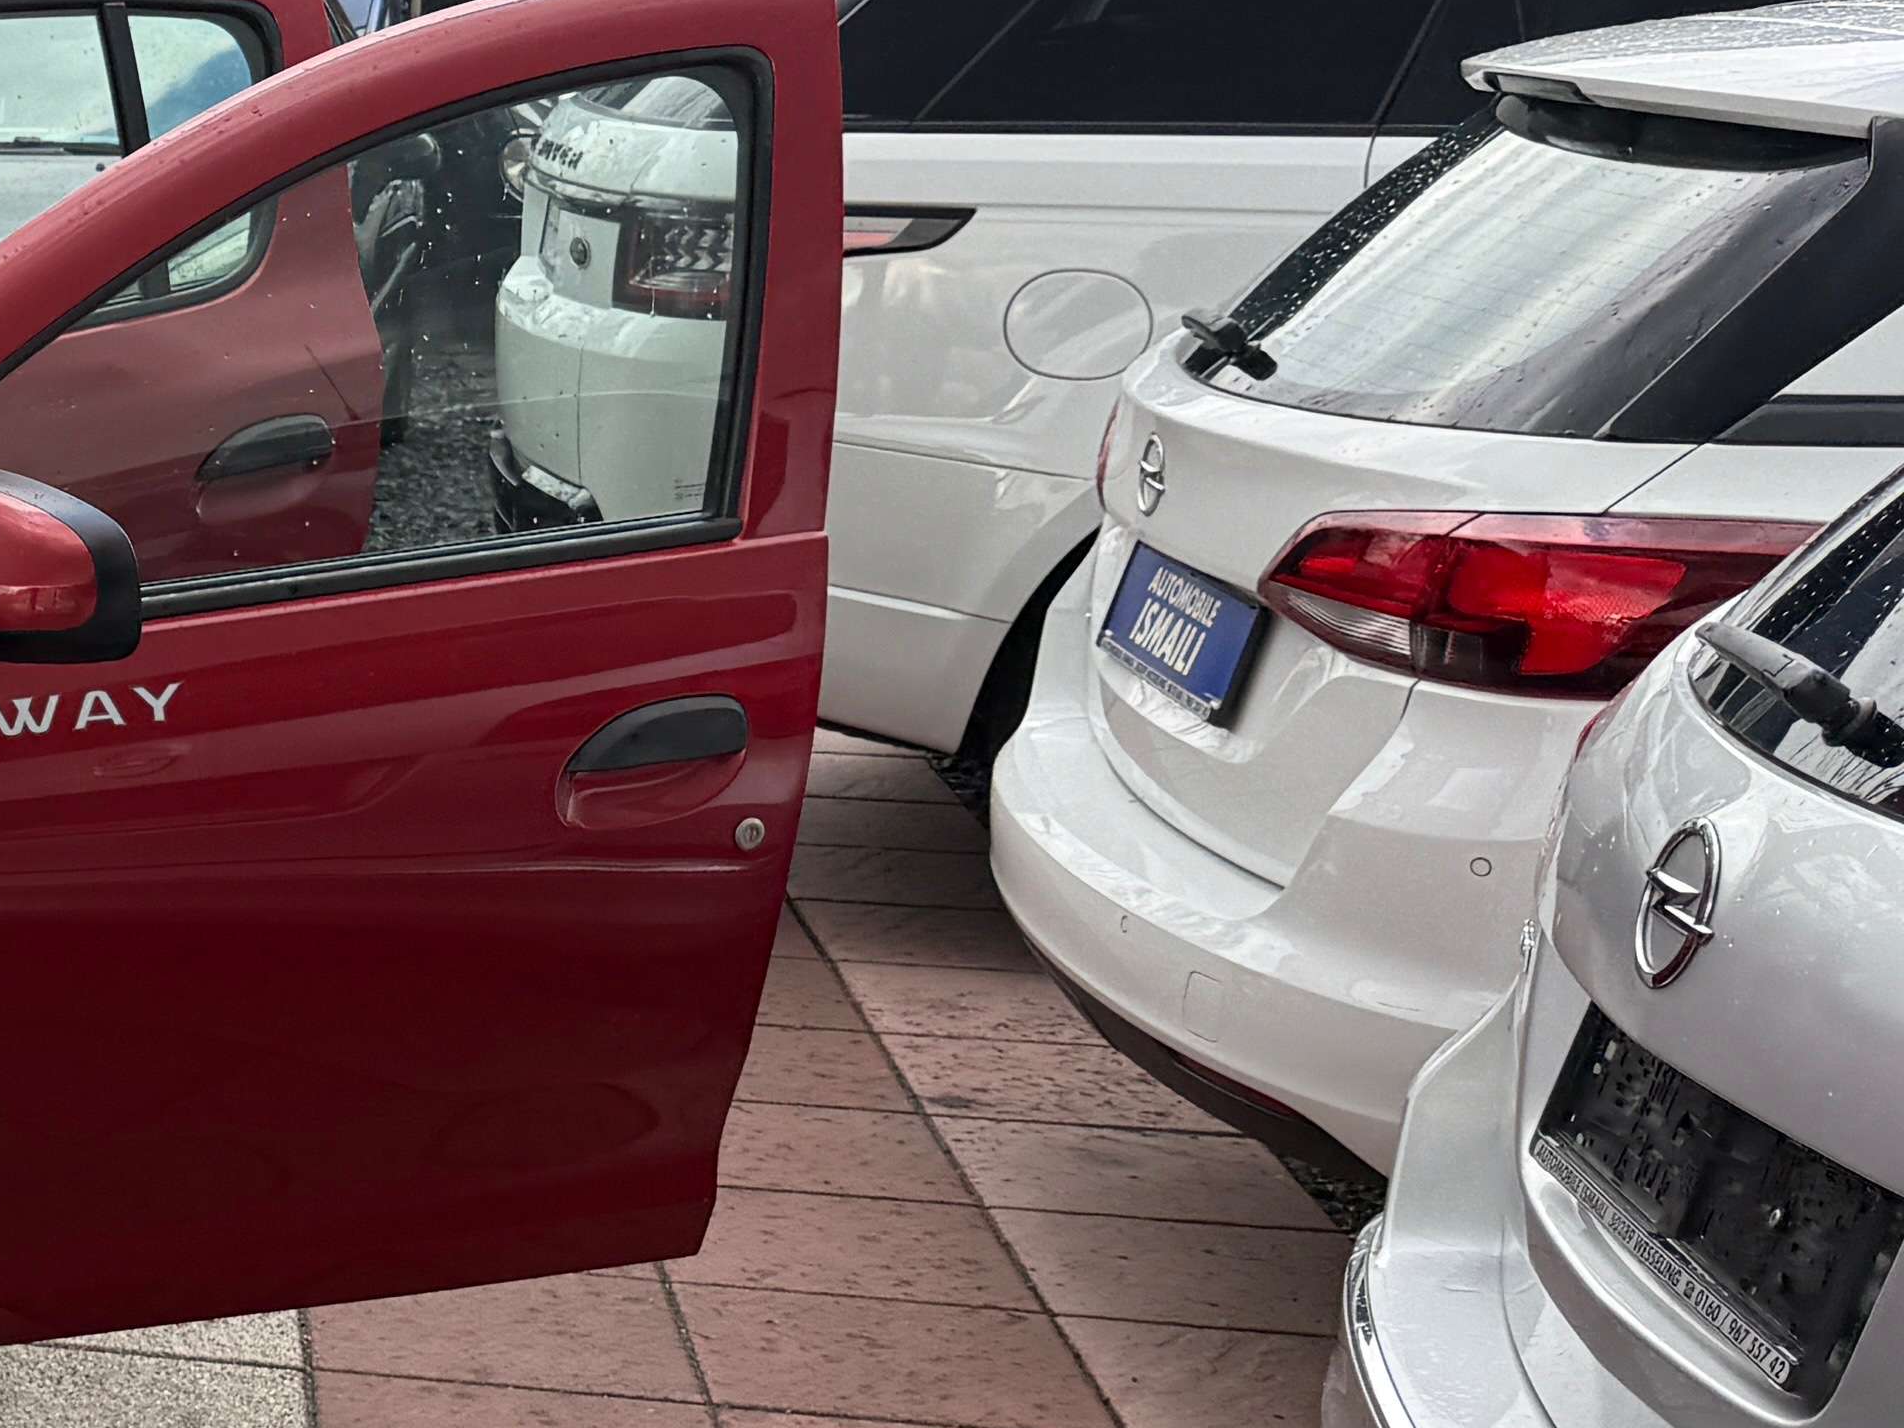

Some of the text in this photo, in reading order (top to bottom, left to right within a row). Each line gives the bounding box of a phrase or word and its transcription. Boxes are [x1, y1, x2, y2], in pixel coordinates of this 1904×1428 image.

[1147, 566, 1222, 628] AUTOMOBILE
[1128, 598, 1206, 676] ISMAILI
[1633, 1234, 1682, 1287] WESSELING
[1694, 1290, 1721, 1322] 0160
[1729, 1318, 1749, 1345] 967
[1747, 1336, 1772, 1363] 557
[1769, 1356, 1786, 1380] 42
